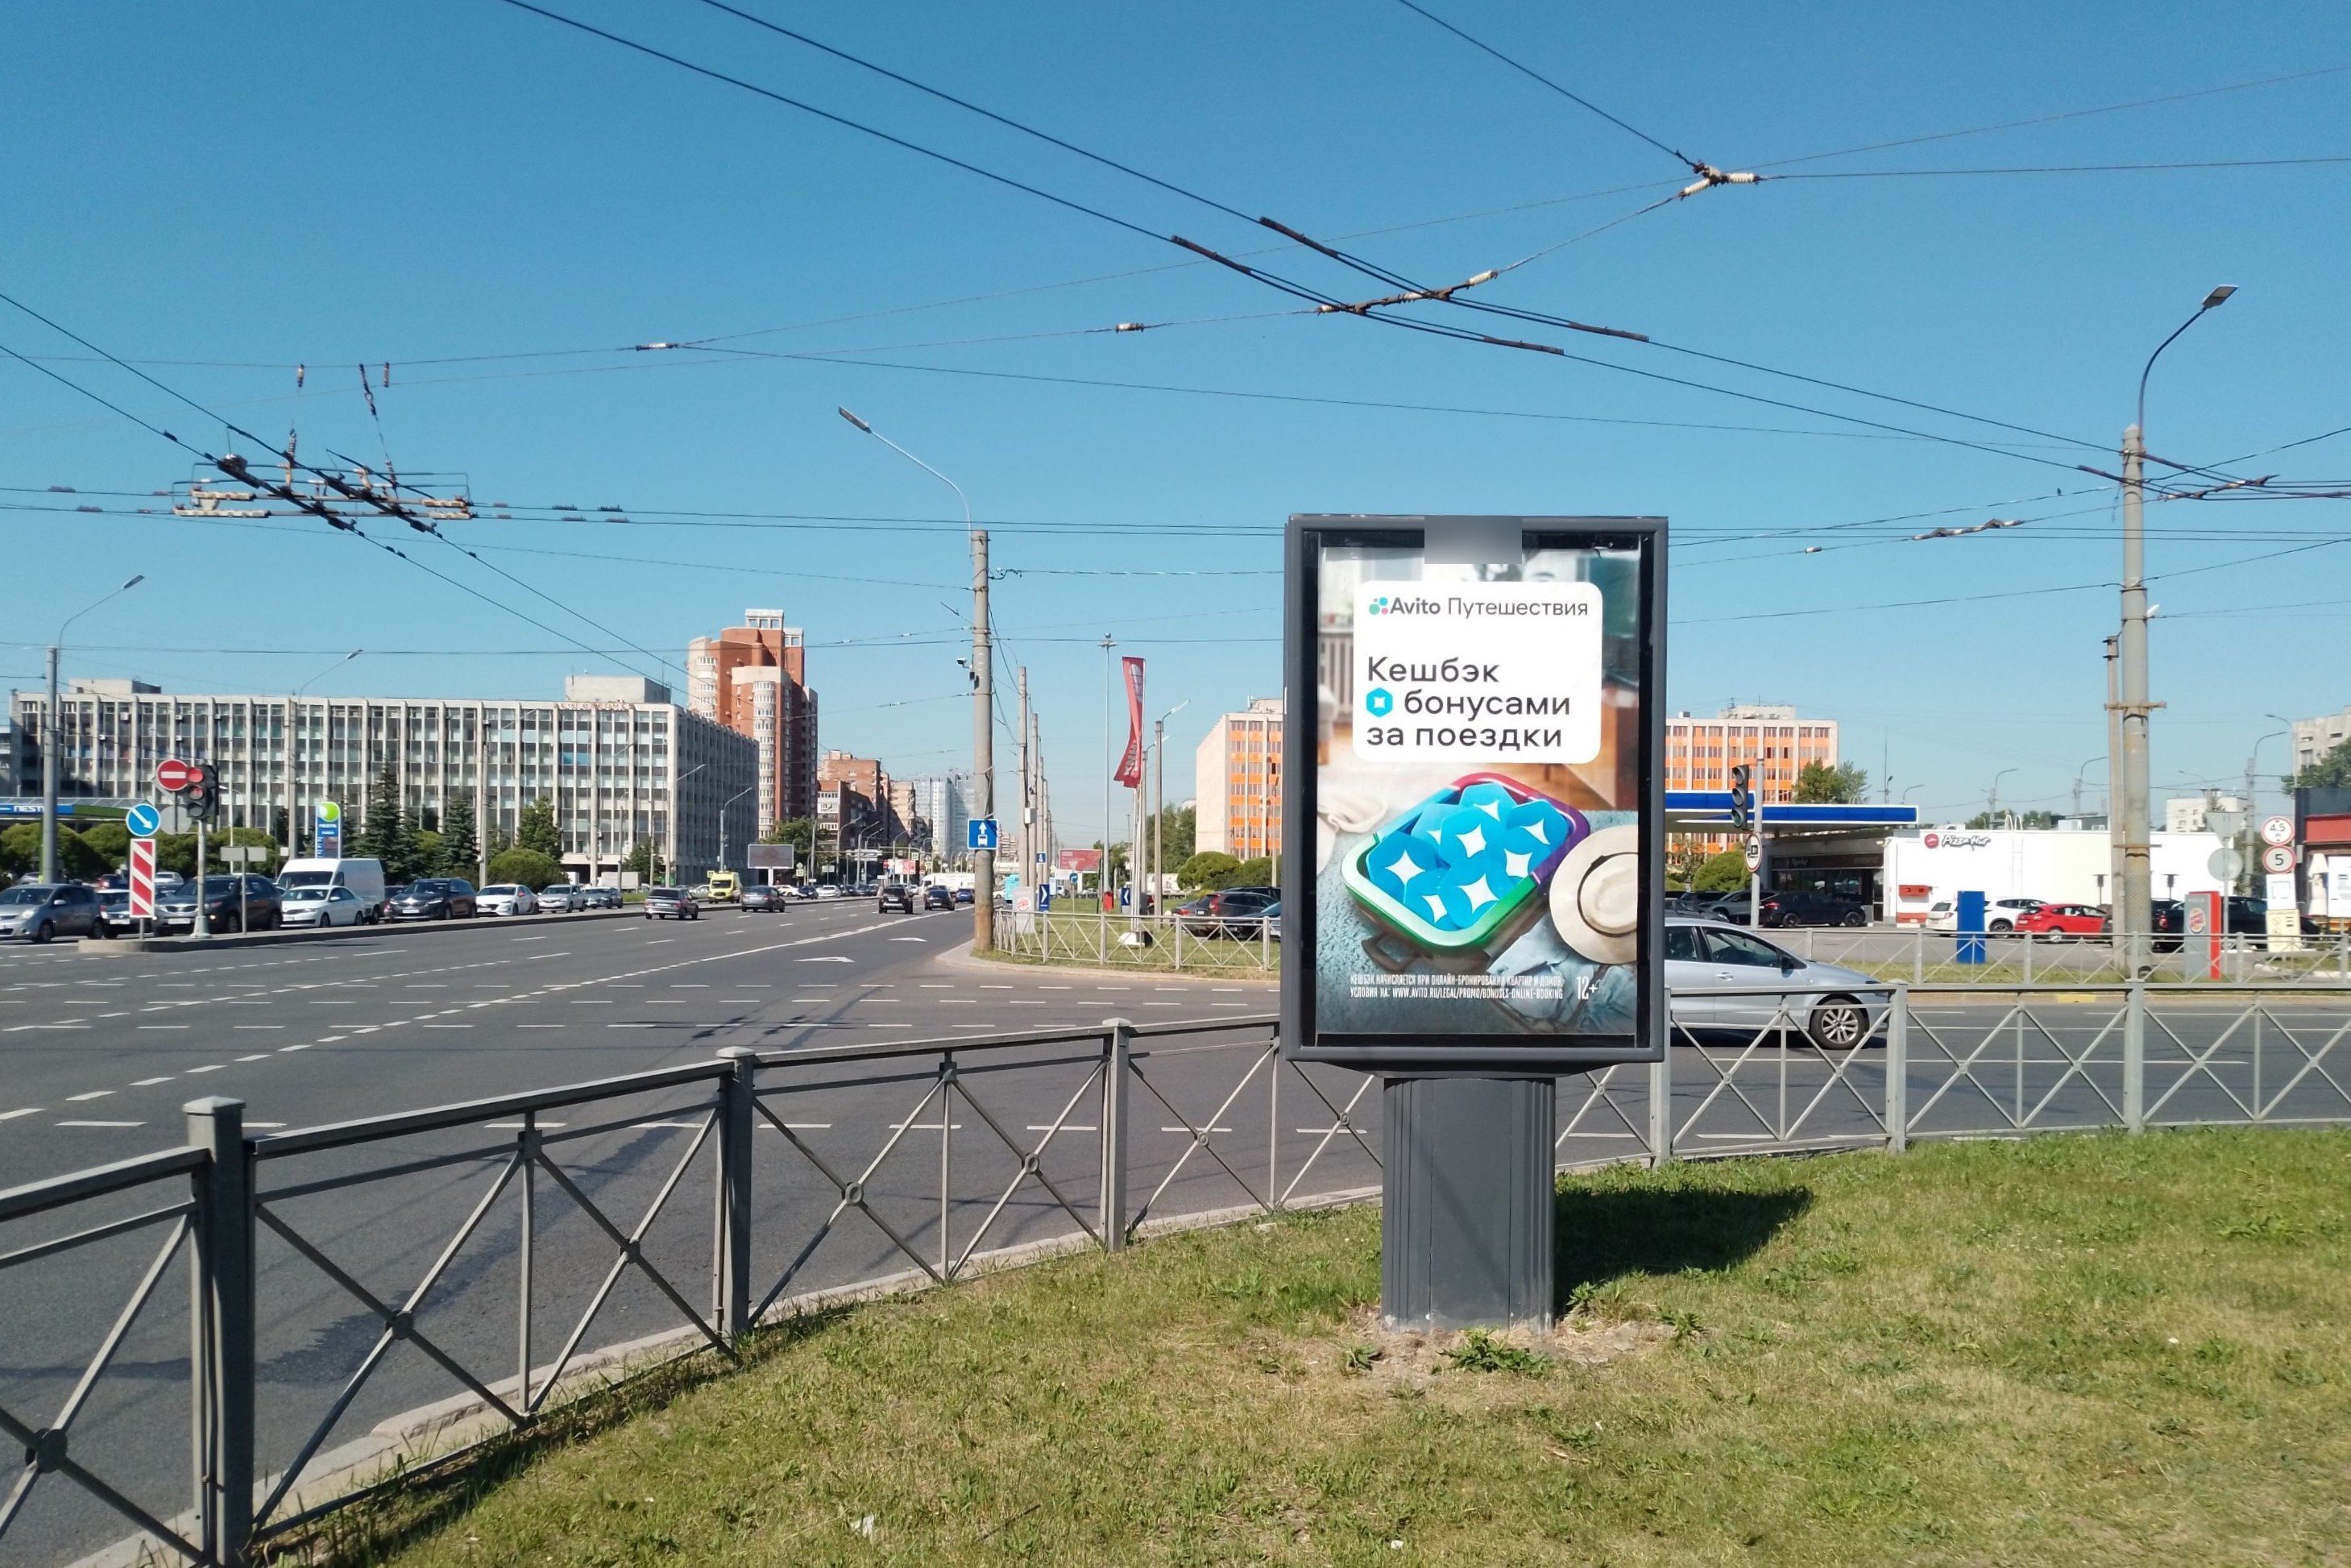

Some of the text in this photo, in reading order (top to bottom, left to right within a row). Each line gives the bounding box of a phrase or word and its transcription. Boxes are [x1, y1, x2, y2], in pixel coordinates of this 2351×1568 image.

[1390, 597, 1588, 619] Avito Путешествия
[1368, 656, 1500, 682] Кешбэк
[1404, 688, 1570, 721] бонусами
[1366, 727, 1562, 751] за поездки
[2275, 853, 2284, 865] 5
[1576, 976, 1598, 1000] 12+
